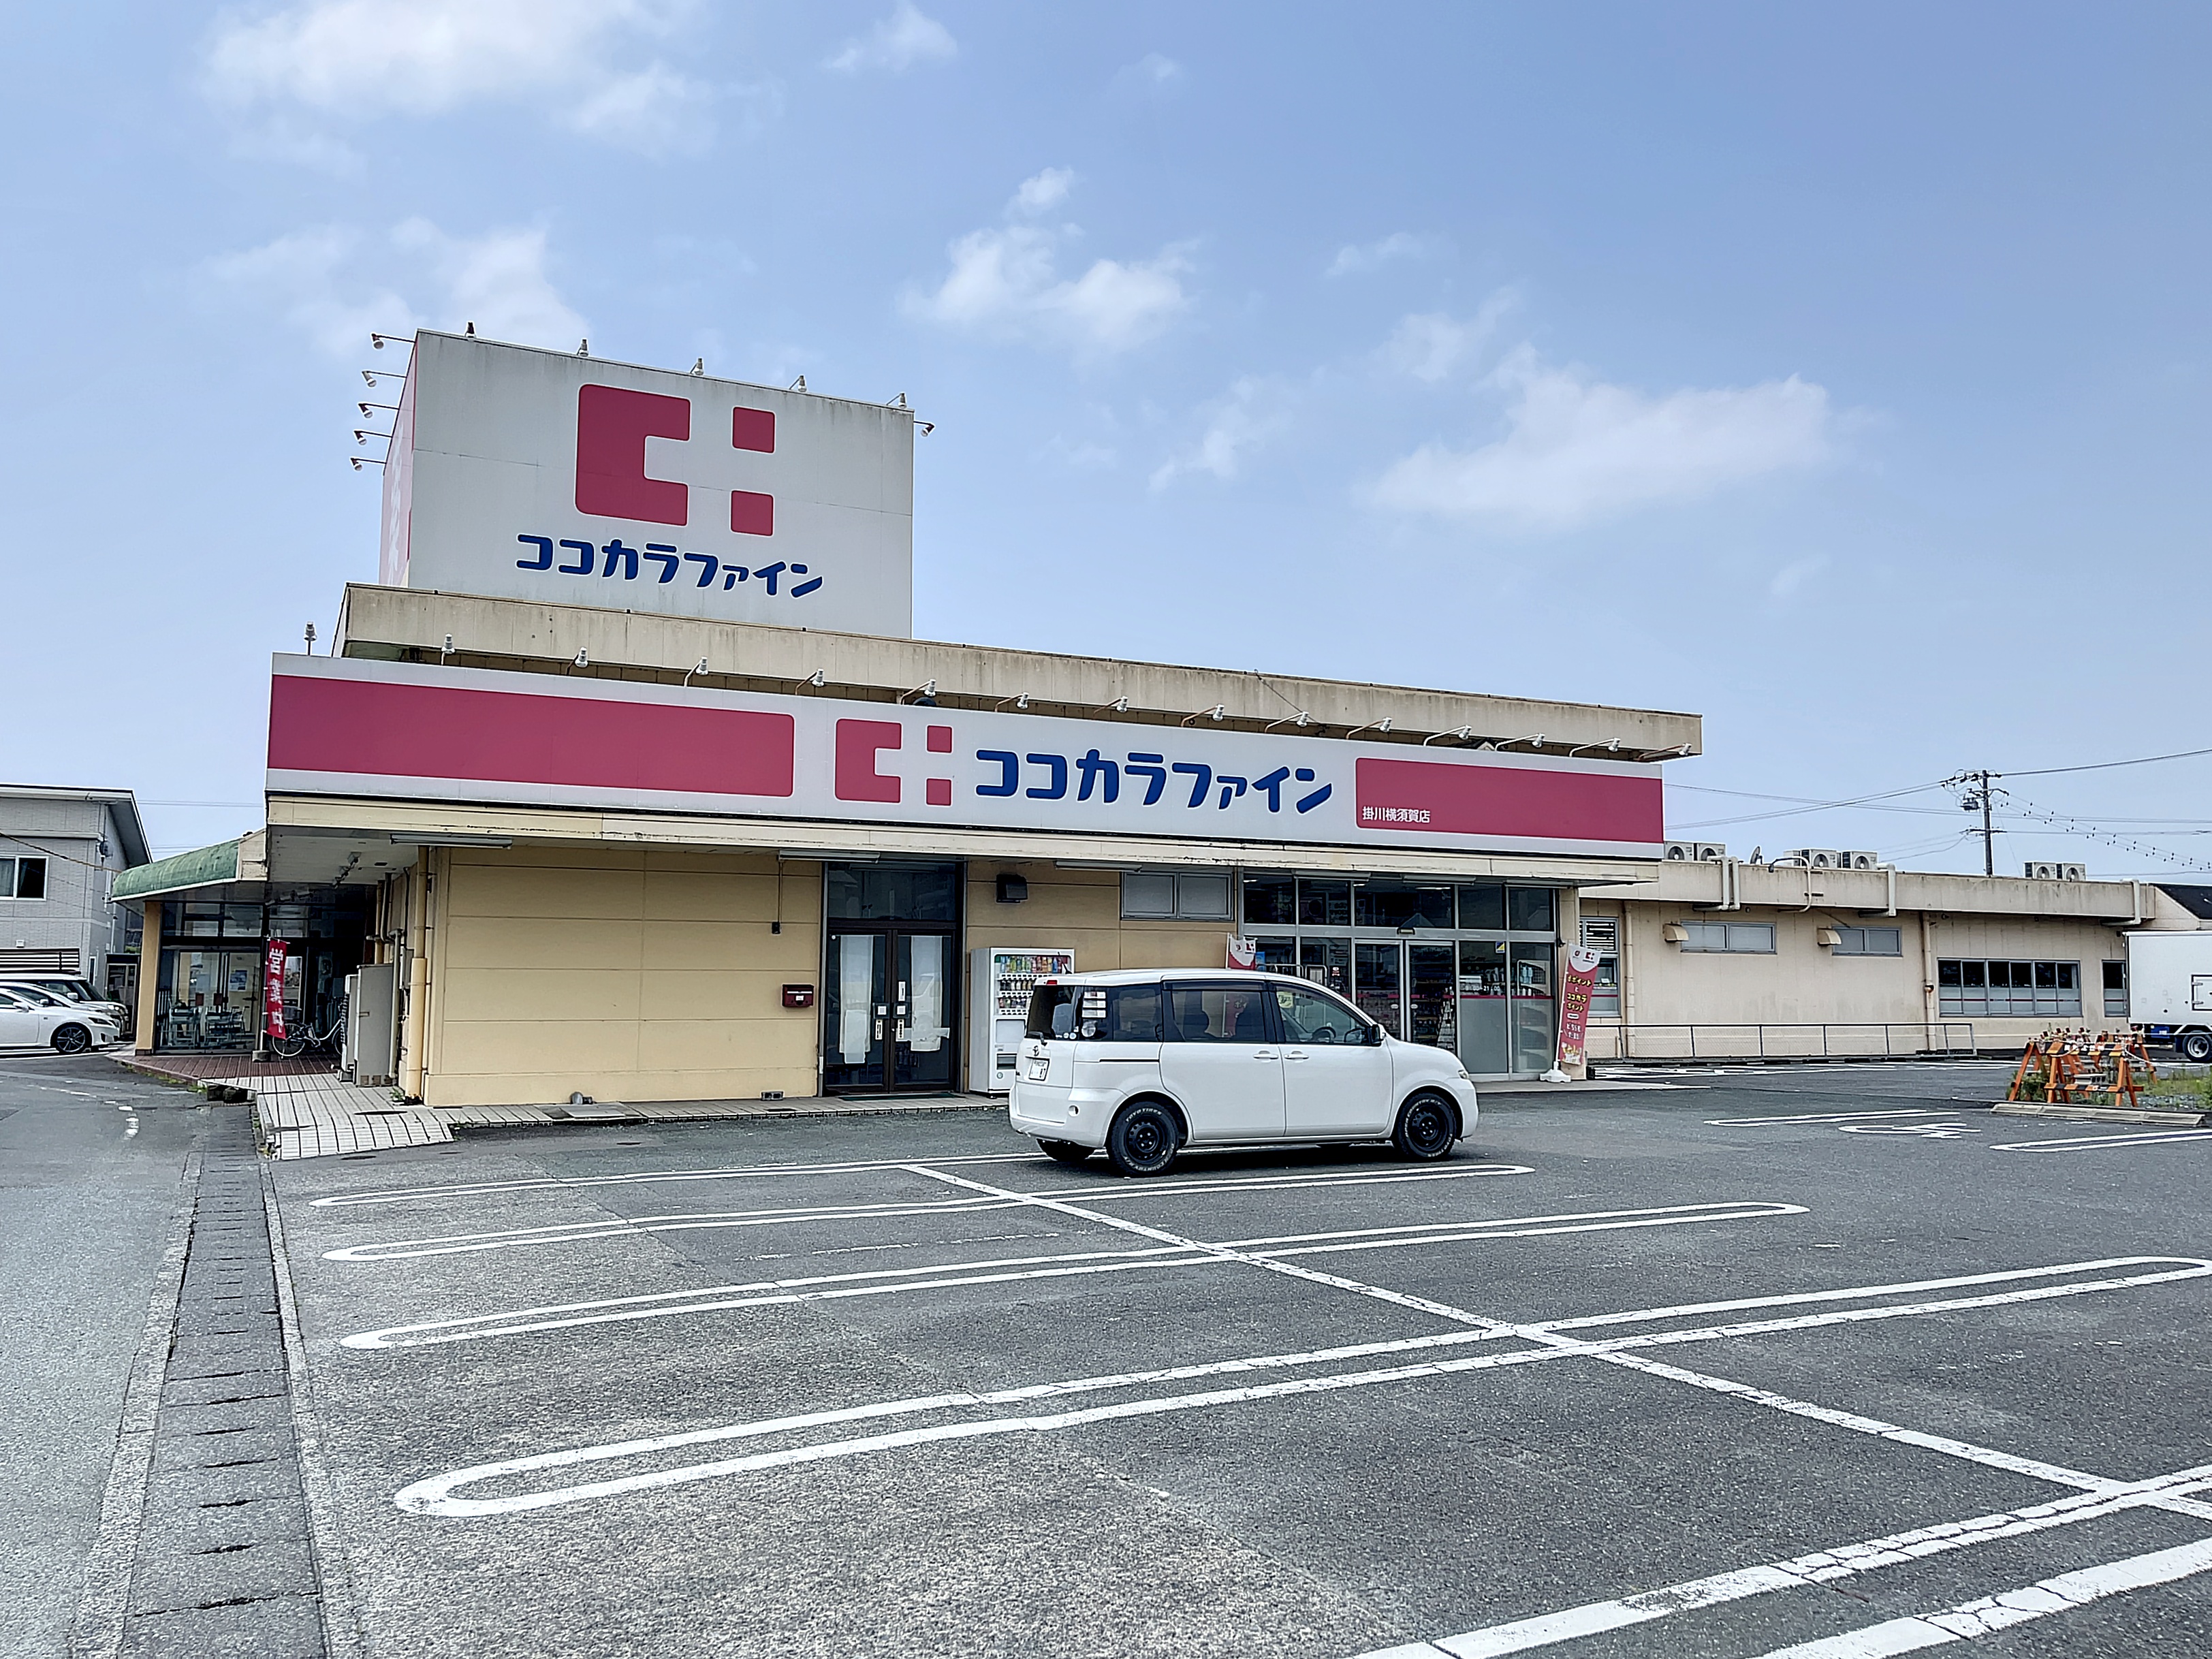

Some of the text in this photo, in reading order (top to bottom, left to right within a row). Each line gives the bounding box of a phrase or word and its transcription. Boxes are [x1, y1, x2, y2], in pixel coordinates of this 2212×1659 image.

[517, 534, 823, 597] ココカラファイン
[976, 748, 1331, 813] ココカラファイン
[1362, 806, 1430, 823] 掛川横須賀店
[269, 947, 283, 1033] 営業中
[1567, 993, 1587, 1003] ココカラ
